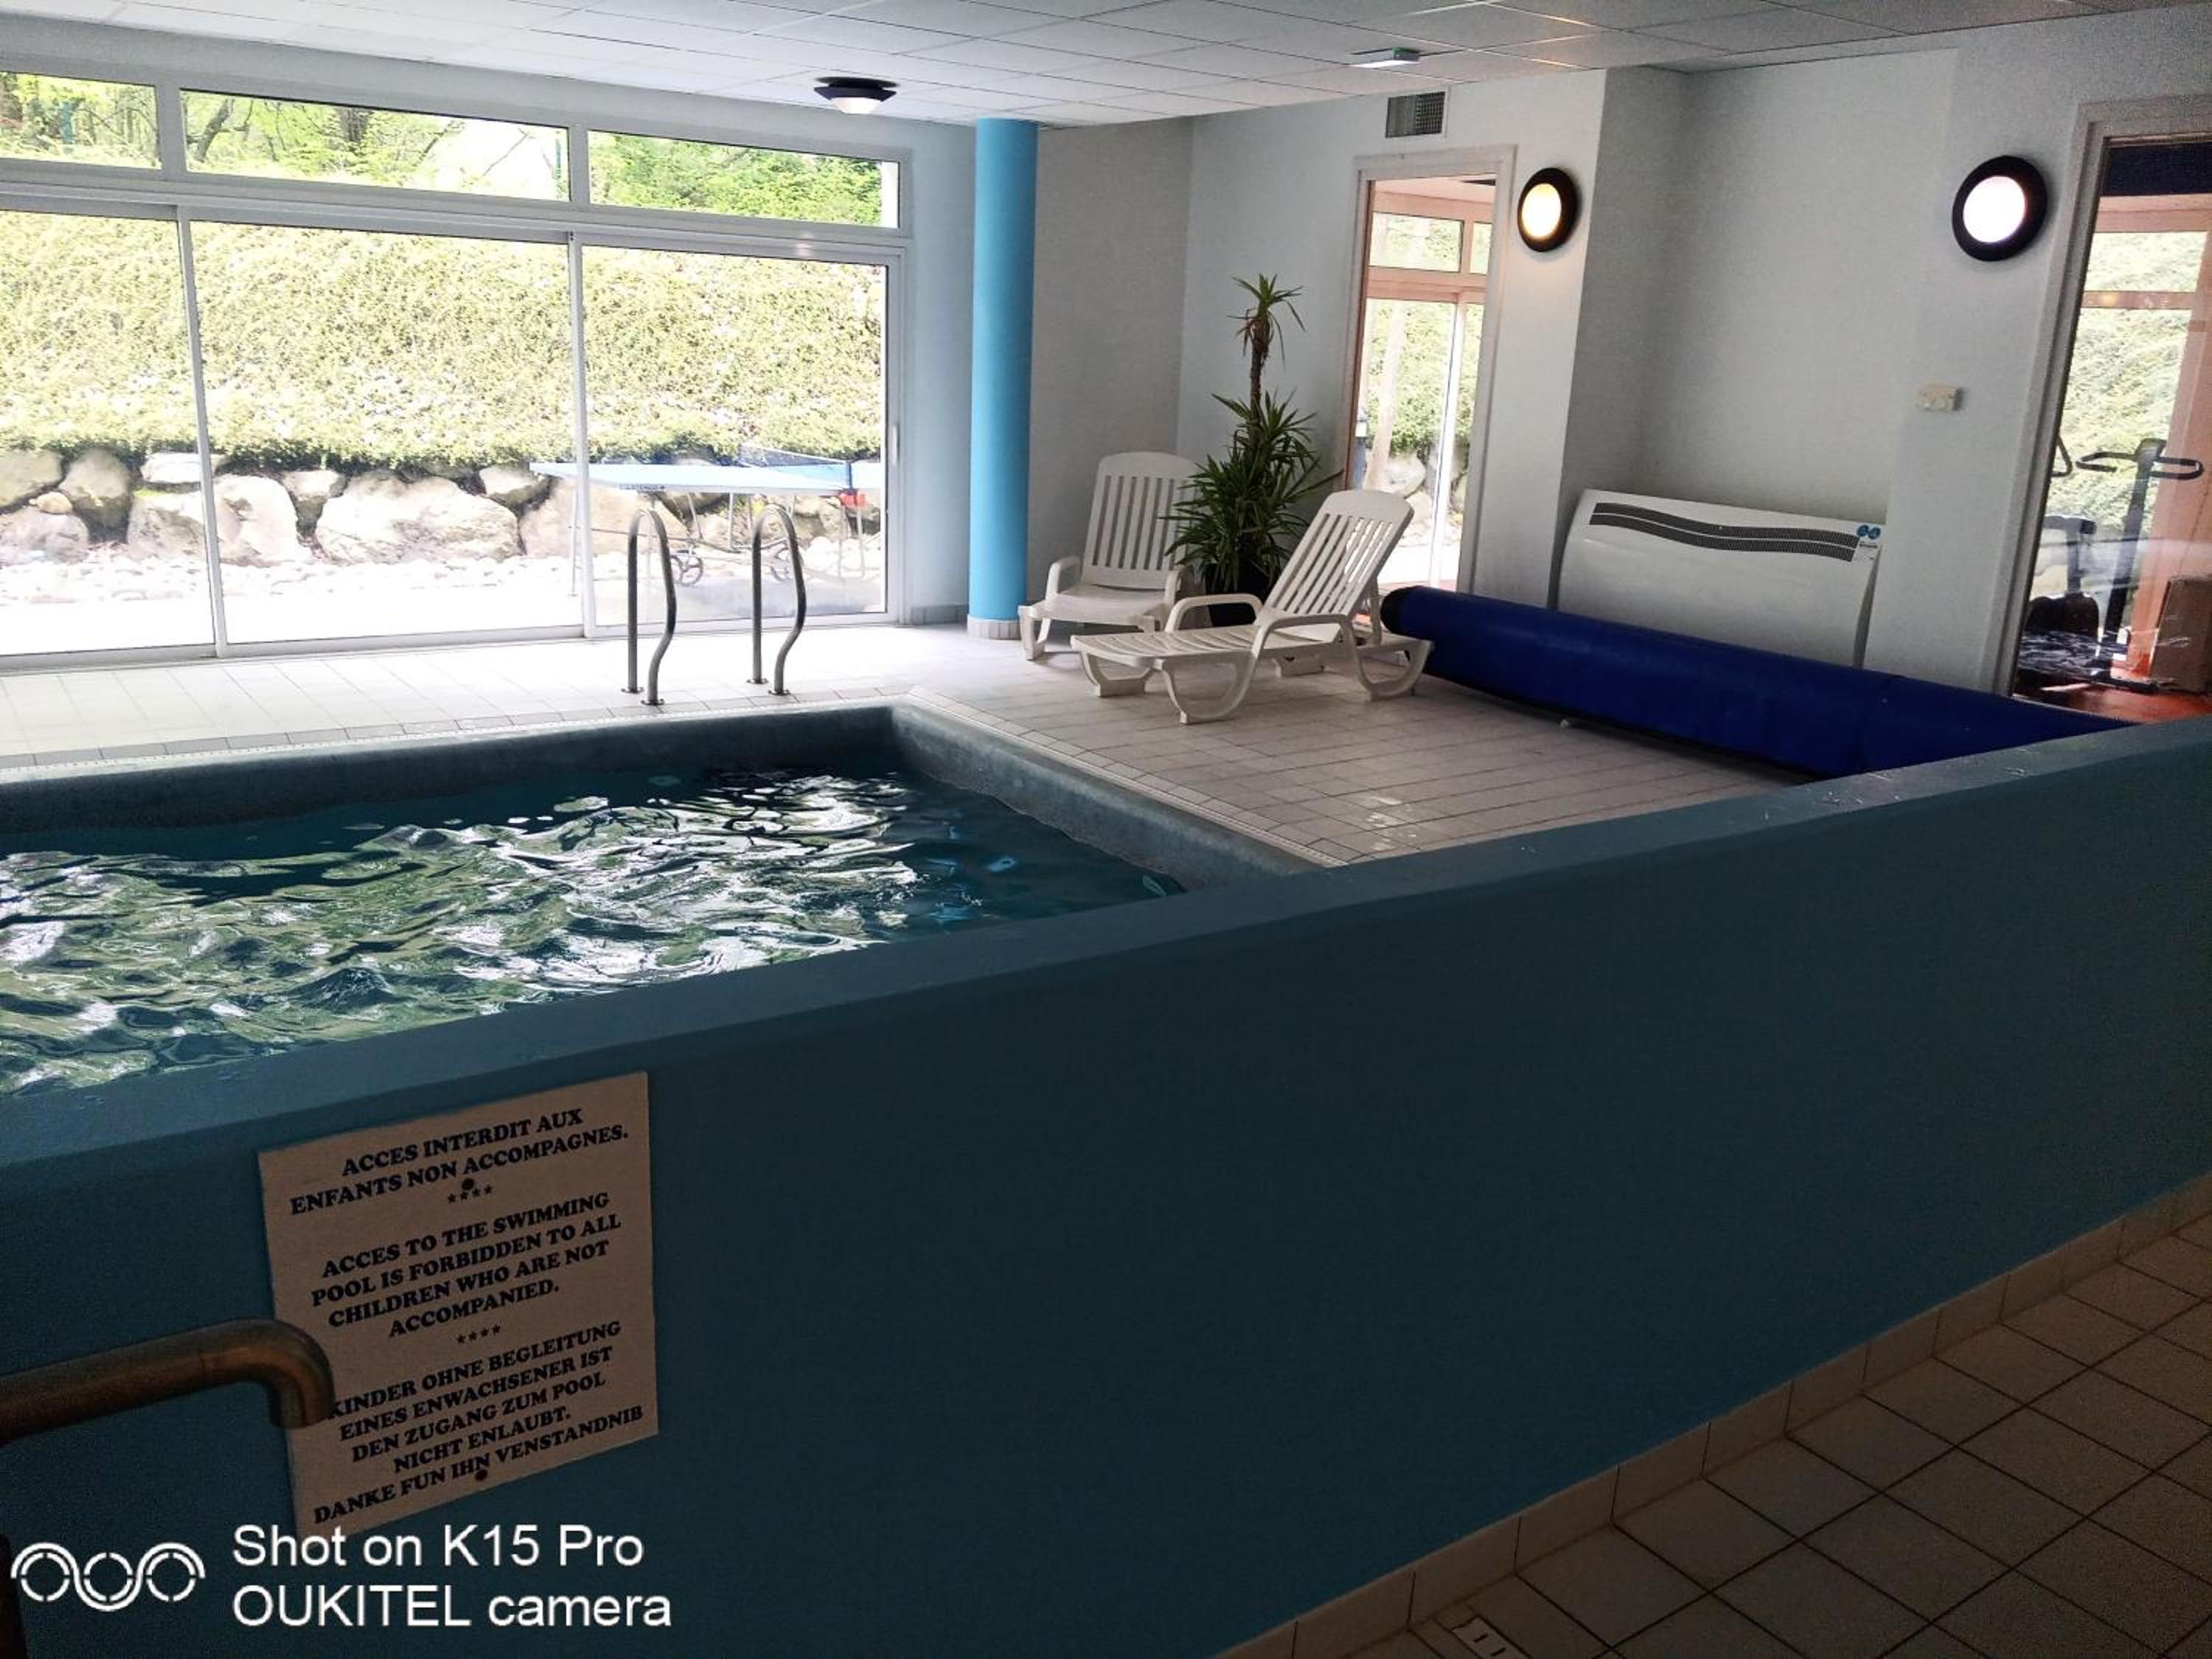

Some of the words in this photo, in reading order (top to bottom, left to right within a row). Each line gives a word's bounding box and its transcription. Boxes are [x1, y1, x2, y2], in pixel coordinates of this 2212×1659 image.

[291, 1175, 403, 1215] ENFANTS
[408, 1161, 456, 1188] NON
[463, 1124, 628, 1173] ACCOMPAGNES.
[342, 1145, 417, 1176] ACCES
[424, 1119, 531, 1158] INTERDIT
[537, 1108, 584, 1132] AUX
[311, 1276, 376, 1307] POOL
[382, 1266, 403, 1288] IS
[409, 1236, 541, 1279] FORBIDDEN
[548, 1225, 575, 1245] TO
[581, 1214, 621, 1237] ALL
[322, 1244, 400, 1279] ACCES
[406, 1235, 437, 1256] TO
[442, 1222, 488, 1247] THE
[494, 1193, 610, 1234] SWIMMING
[329, 1281, 450, 1326] CHILDREN
[456, 1266, 509, 1294] WHO
[515, 1252, 560, 1278] ARE
[565, 1240, 609, 1265] NOT
[389, 1280, 559, 1337] ACCOMPANIED.
[340, 1408, 407, 1441] EINES
[414, 1359, 576, 1417] ENWACHSENER
[581, 1347, 613, 1368] IST
[422, 1360, 483, 1389] OHNE
[489, 1321, 621, 1370] BEGLEITUNG
[352, 1436, 399, 1461] DEN
[405, 1406, 497, 1444] ZUGANG
[502, 1391, 548, 1414] ZUM
[552, 1372, 605, 1399] POOL
[393, 1441, 460, 1473] NICHT
[468, 1407, 570, 1450] ENLAUBT.
[313, 1484, 395, 1523] DANKE
[401, 1469, 445, 1494] FUN
